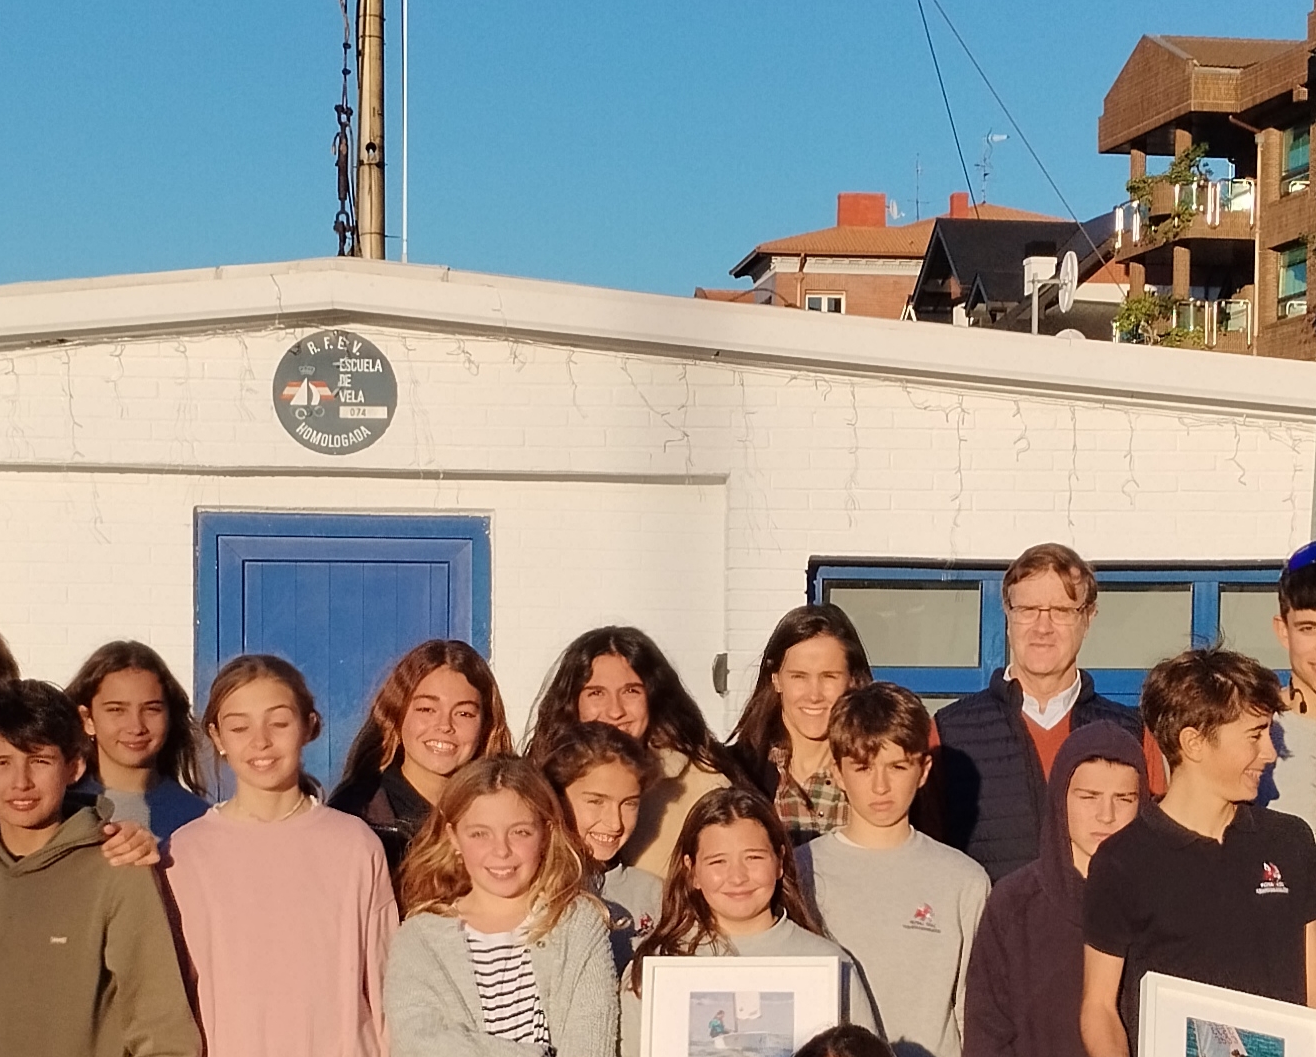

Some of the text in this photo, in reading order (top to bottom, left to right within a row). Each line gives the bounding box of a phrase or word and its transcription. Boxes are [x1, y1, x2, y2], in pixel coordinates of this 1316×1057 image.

[339, 358, 383, 373] ESCUELA
[339, 374, 352, 388] DE
[340, 389, 365, 403] VELA
[349, 407, 368, 418] 074
[295, 421, 373, 448] HOMOLOGADA
